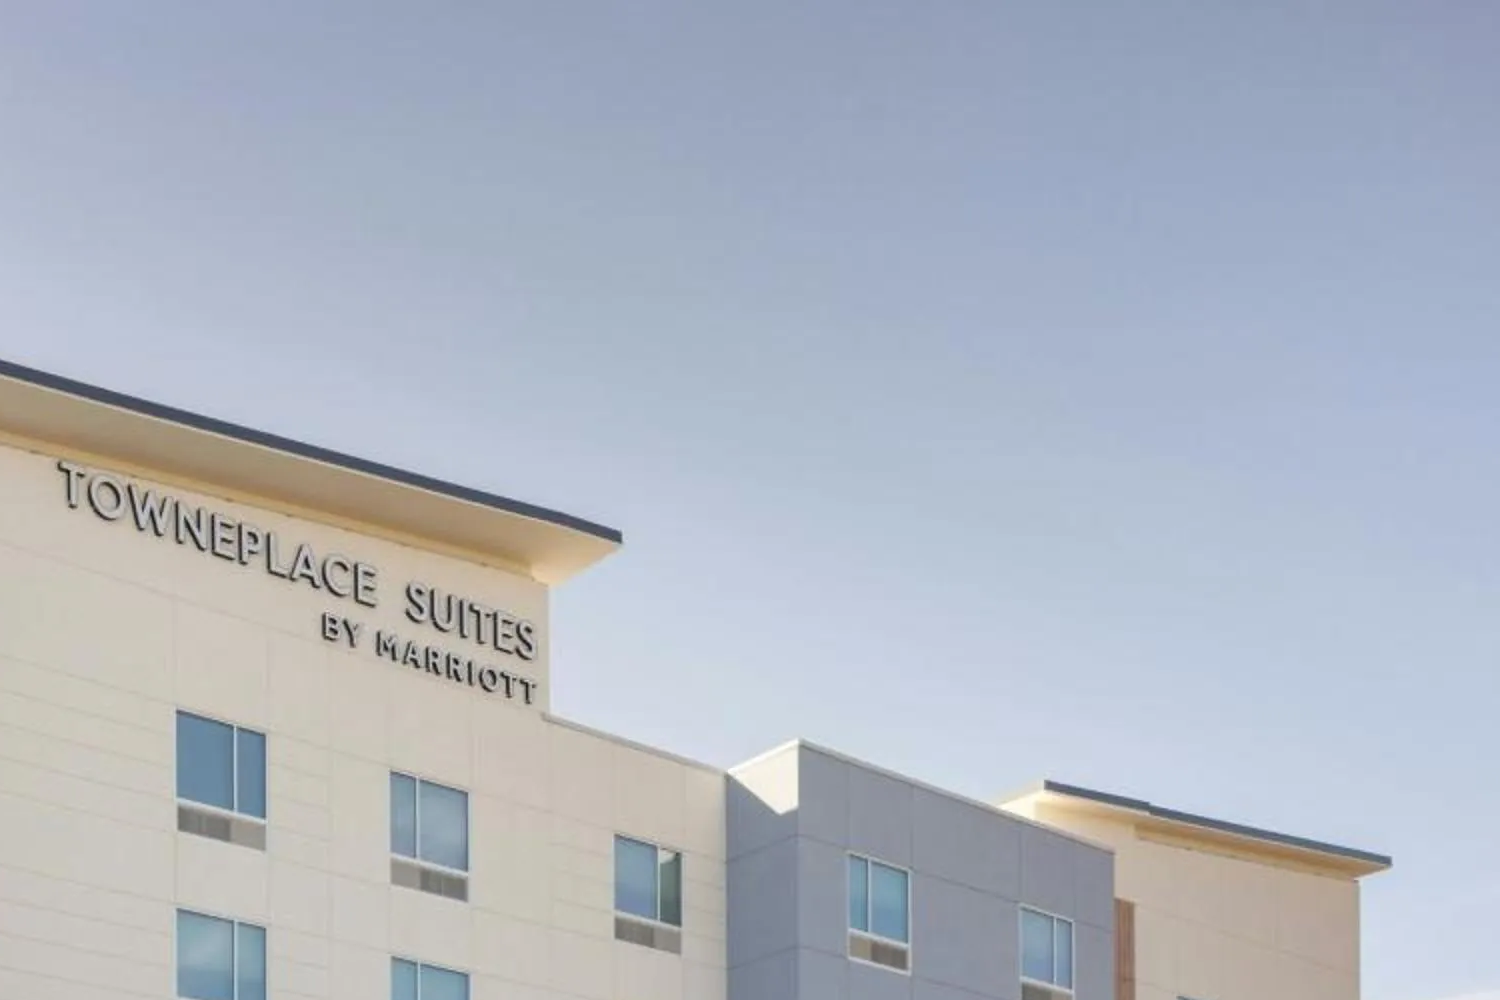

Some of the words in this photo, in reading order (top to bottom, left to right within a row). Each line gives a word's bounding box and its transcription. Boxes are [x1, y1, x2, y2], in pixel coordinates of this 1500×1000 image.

[57, 460, 377, 608] TOWNEPLACE
[405, 580, 539, 661] SUITES
[321, 611, 365, 648] BY
[375, 629, 538, 705] MARRIOTT
